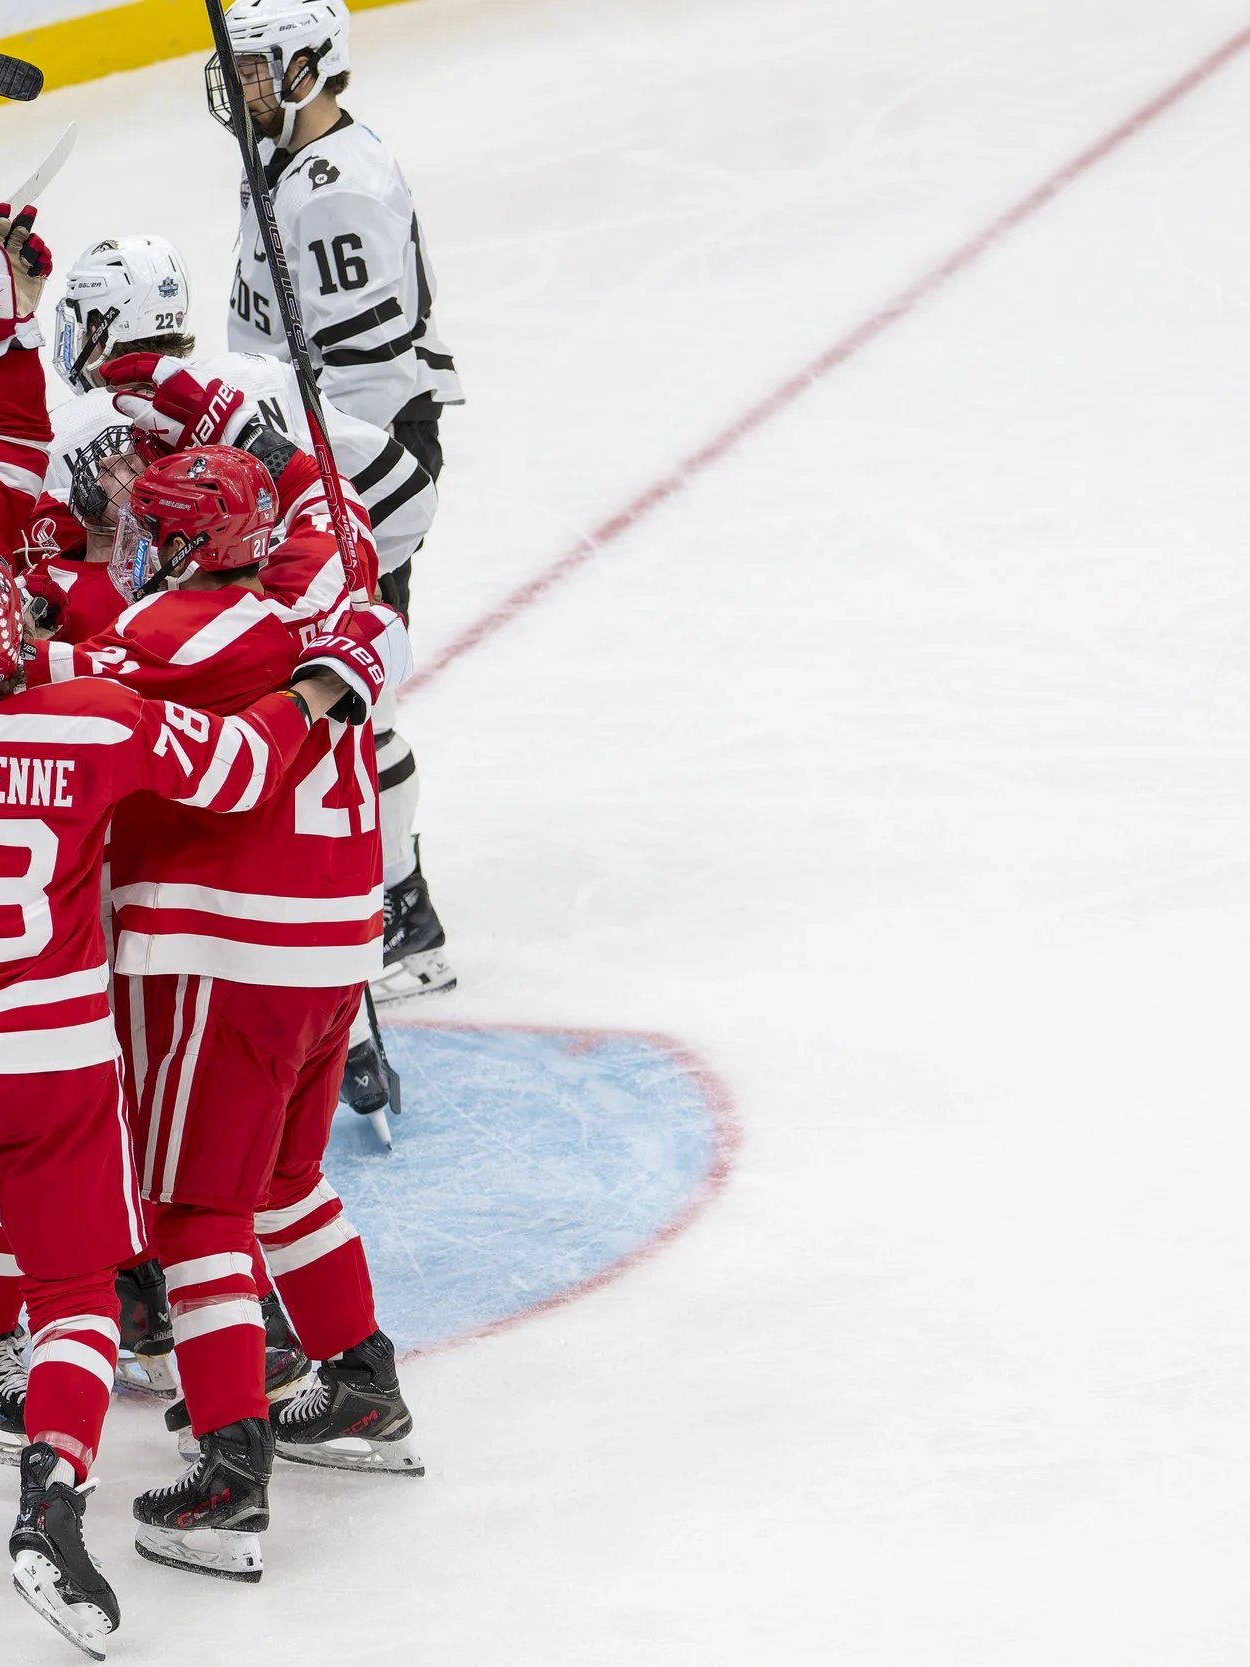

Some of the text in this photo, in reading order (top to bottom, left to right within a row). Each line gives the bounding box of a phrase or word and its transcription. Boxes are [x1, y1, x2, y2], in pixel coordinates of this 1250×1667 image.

[308, 233, 369, 296] 16
[155, 313, 174, 330] 22
[253, 537, 266, 559] 21
[153, 700, 211, 777] 78
[177, 1487, 231, 1529] CCM
